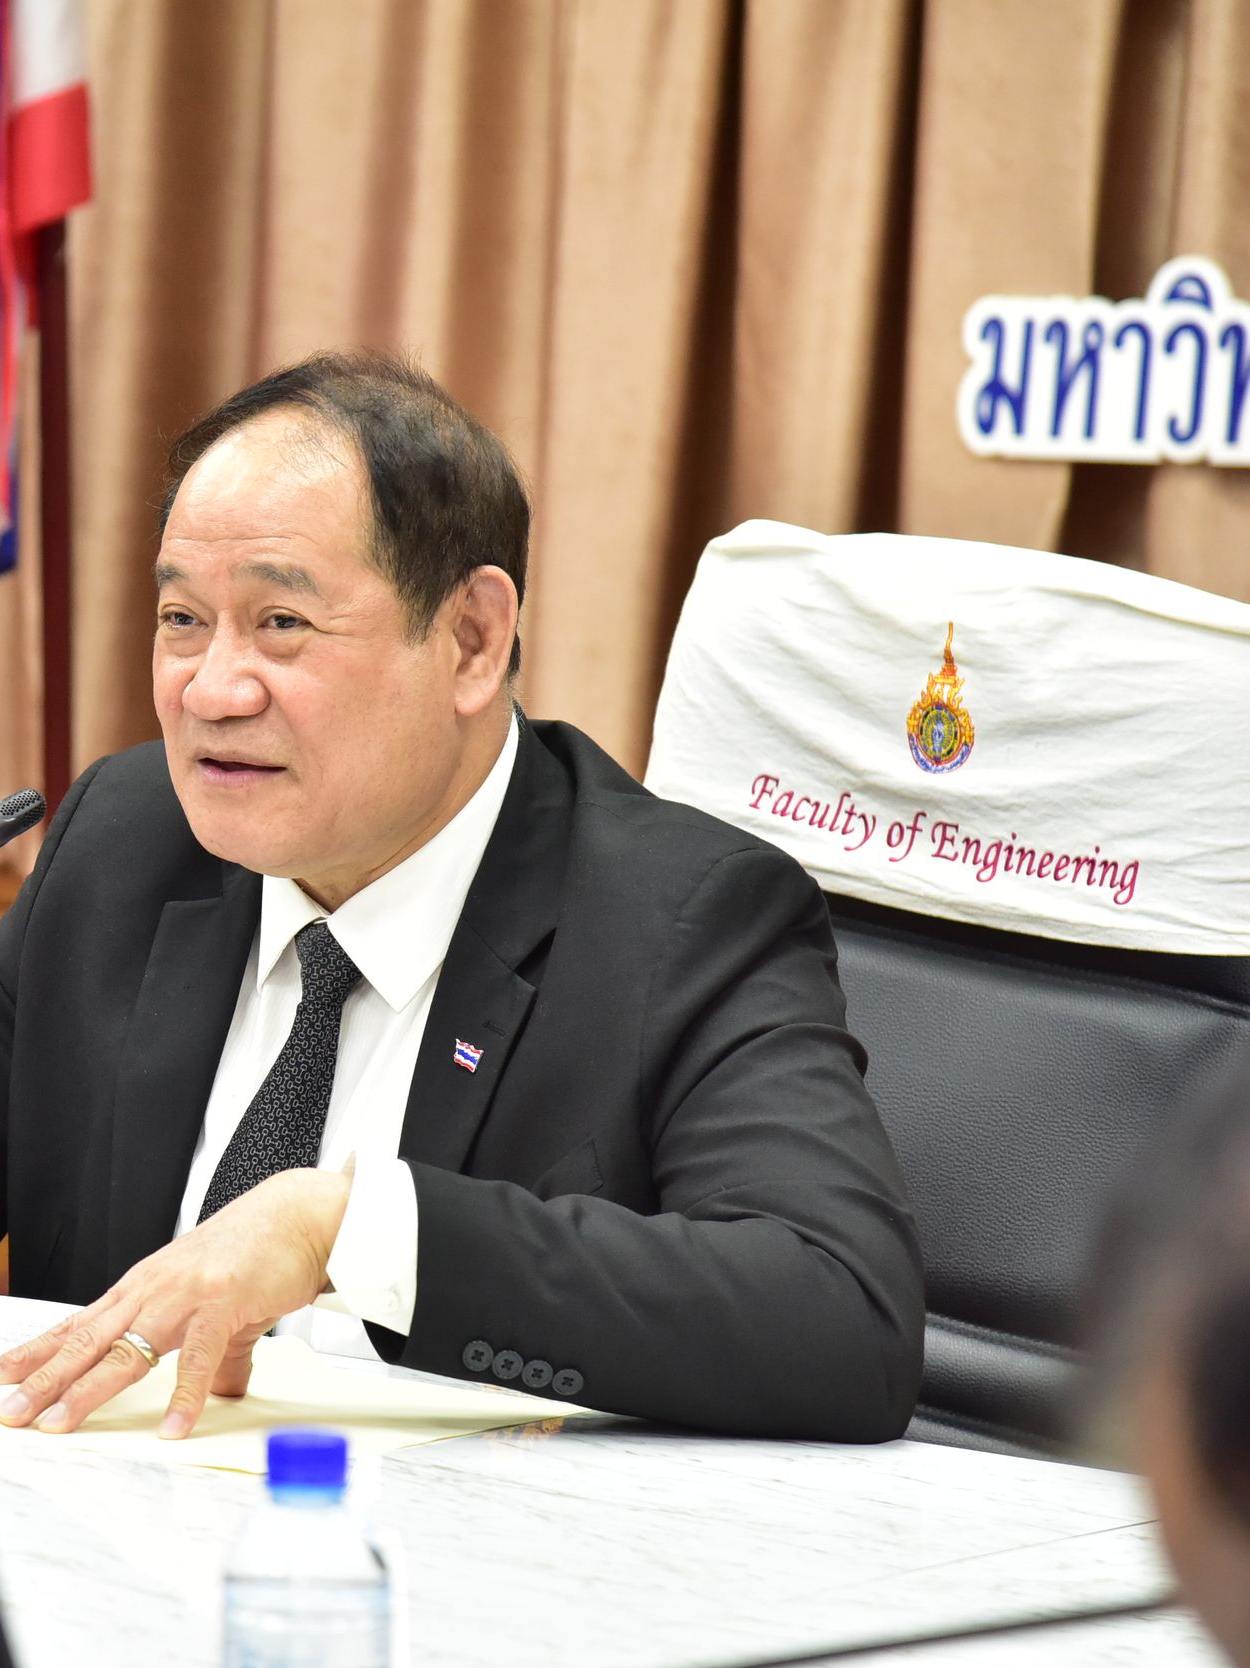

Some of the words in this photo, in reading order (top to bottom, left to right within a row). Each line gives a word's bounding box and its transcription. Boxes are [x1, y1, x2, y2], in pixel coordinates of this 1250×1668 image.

[749, 774, 876, 851] Faculty
[886, 811, 927, 862] of
[931, 820, 1140, 905] Engineering
